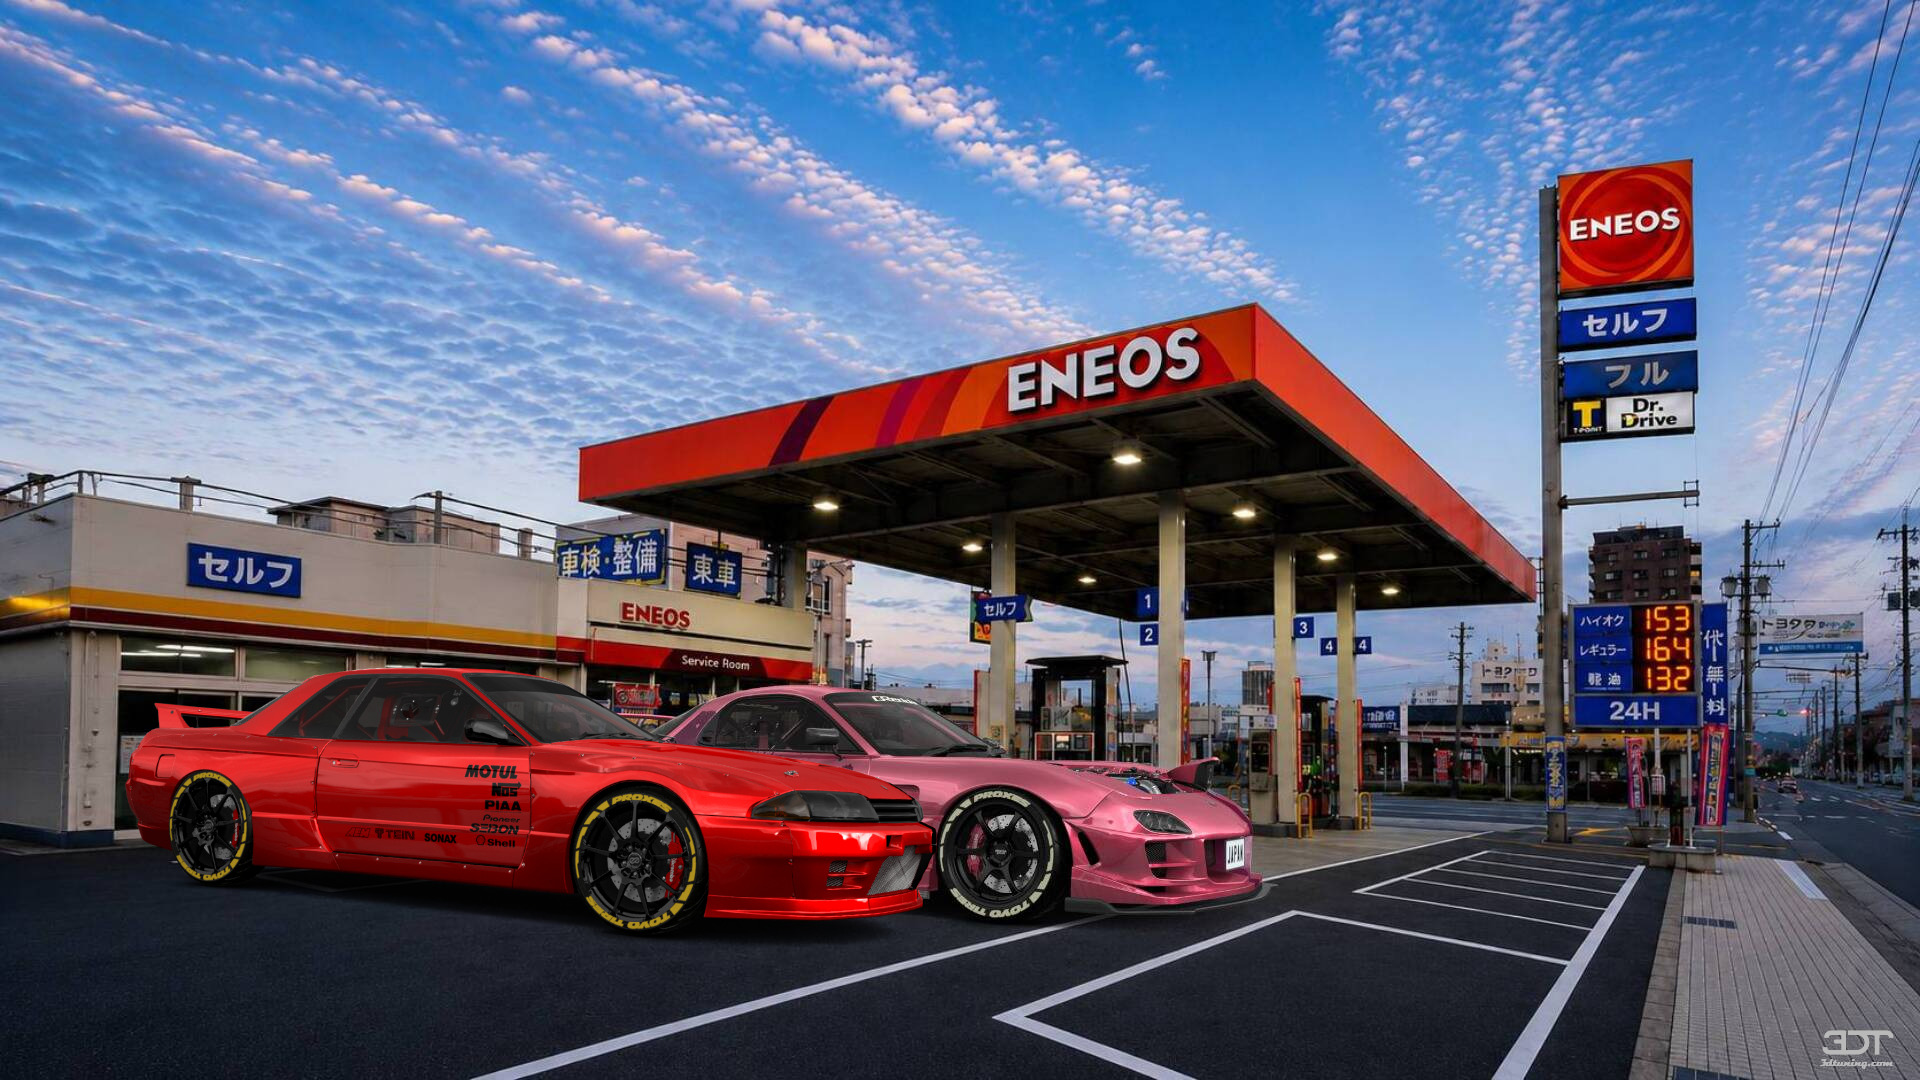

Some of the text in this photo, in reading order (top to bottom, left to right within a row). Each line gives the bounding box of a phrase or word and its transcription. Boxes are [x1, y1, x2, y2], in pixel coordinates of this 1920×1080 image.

[1570, 207, 1680, 241] ENEOS
[1582, 308, 1668, 337] セルフ
[1008, 327, 1200, 412] ENEOS
[1605, 361, 1670, 388] フル
[1633, 398, 1663, 413] Dr.
[1572, 400, 1601, 428] T
[1621, 413, 1677, 428] Drive
[198, 551, 293, 588] セルフ
[983, 601, 1016, 617] セルフ
[1144, 594, 1151, 609] 1
[621, 602, 691, 629] ENEOS
[1580, 605, 1690, 632] ハイオク 153
[1144, 627, 1153, 642] 2
[1300, 621, 1308, 634] 3
[1325, 640, 1333, 652] 4
[1359, 639, 1367, 651] 4
[1579, 636, 1690, 662] レギュラー 164
[681, 655, 750, 671] Service Room
[1647, 666, 1690, 691] 132
[1609, 701, 1661, 720] 24H
[465, 764, 517, 779] MOTUL
[484, 799, 522, 811] PIAA
[611, 793, 673, 813] PROXES
[482, 813, 521, 823] Pioneer
[385, 830, 415, 840] TEIN
[469, 823, 520, 835] SEBON
[424, 832, 457, 844] SONAX
[487, 838, 516, 848] Shell
[1227, 844, 1244, 864] JAPAN
[989, 900, 1030, 918] TOYO
[626, 912, 671, 930] TOYO
